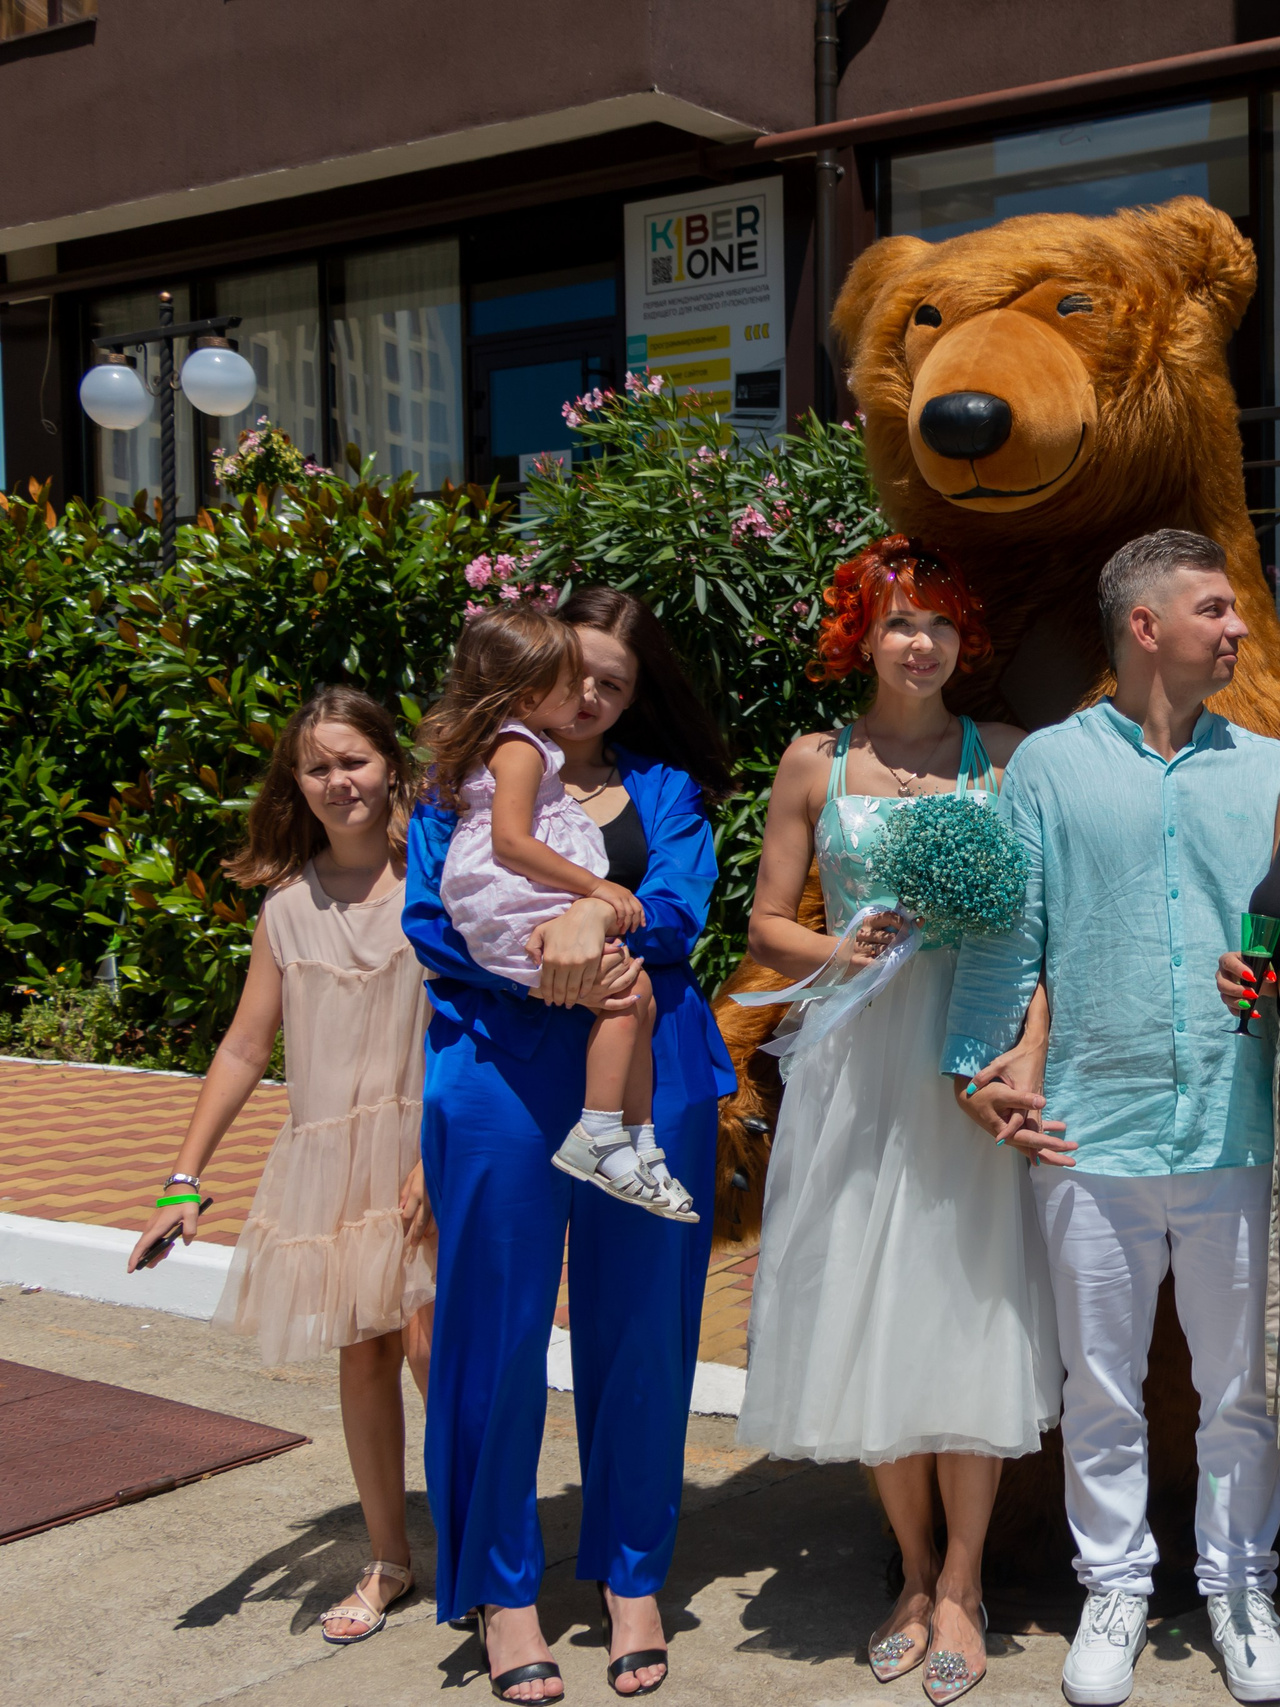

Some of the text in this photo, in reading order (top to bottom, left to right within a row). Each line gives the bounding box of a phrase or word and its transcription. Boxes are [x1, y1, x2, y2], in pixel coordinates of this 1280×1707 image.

[686, 240, 759, 279] ONE
[643, 284, 770, 309] ПЕРВАЯ МЕЖДУНАРОДНАЯ КИБЕРШКОЛА
[679, 305, 692, 315] ДЛЯ
[693, 301, 720, 312] НОВОГО
